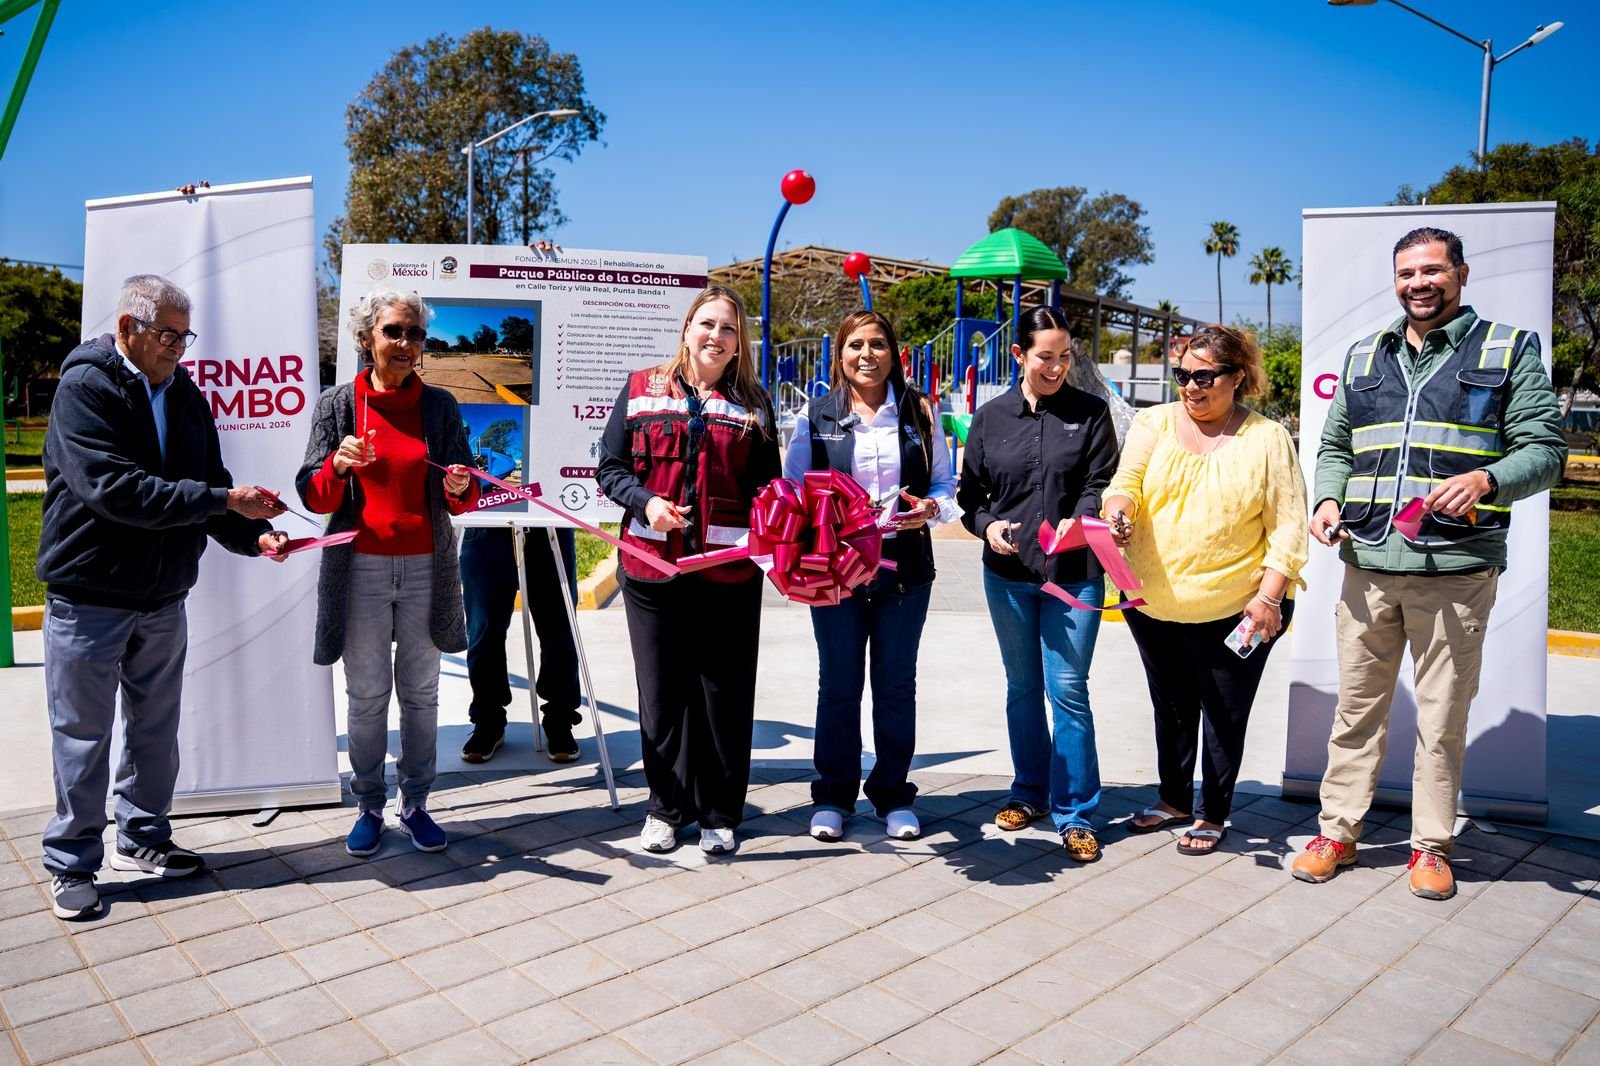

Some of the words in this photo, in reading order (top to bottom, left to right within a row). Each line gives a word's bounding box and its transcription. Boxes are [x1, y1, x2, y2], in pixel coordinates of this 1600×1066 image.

[604, 260, 654, 269] Rehabilitación
[392, 267, 428, 276] México
[499, 268, 544, 280] Parque
[548, 269, 594, 281] Público
[598, 272, 614, 282] de
[617, 273, 628, 283] la
[632, 274, 680, 286] Colonia
[201, 386, 306, 420] MBO
[270, 420, 291, 428] 2026
